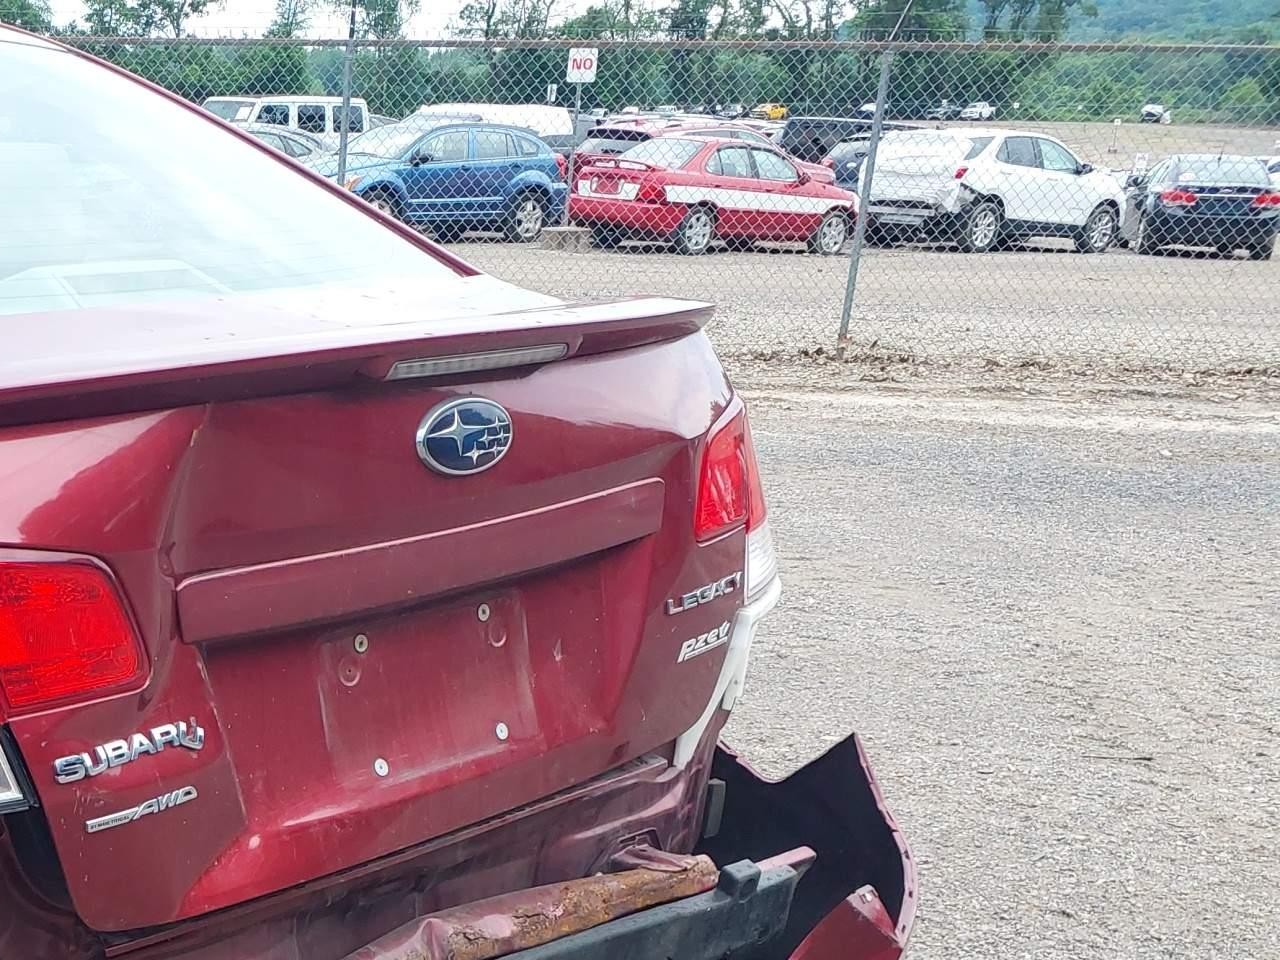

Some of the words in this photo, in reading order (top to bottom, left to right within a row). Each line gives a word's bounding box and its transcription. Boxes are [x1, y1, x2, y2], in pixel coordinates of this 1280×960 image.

[572, 58, 593, 70] NO
[666, 571, 742, 615] LEGACY
[55, 717, 204, 783] SUBARU
[134, 785, 198, 820] AWD
